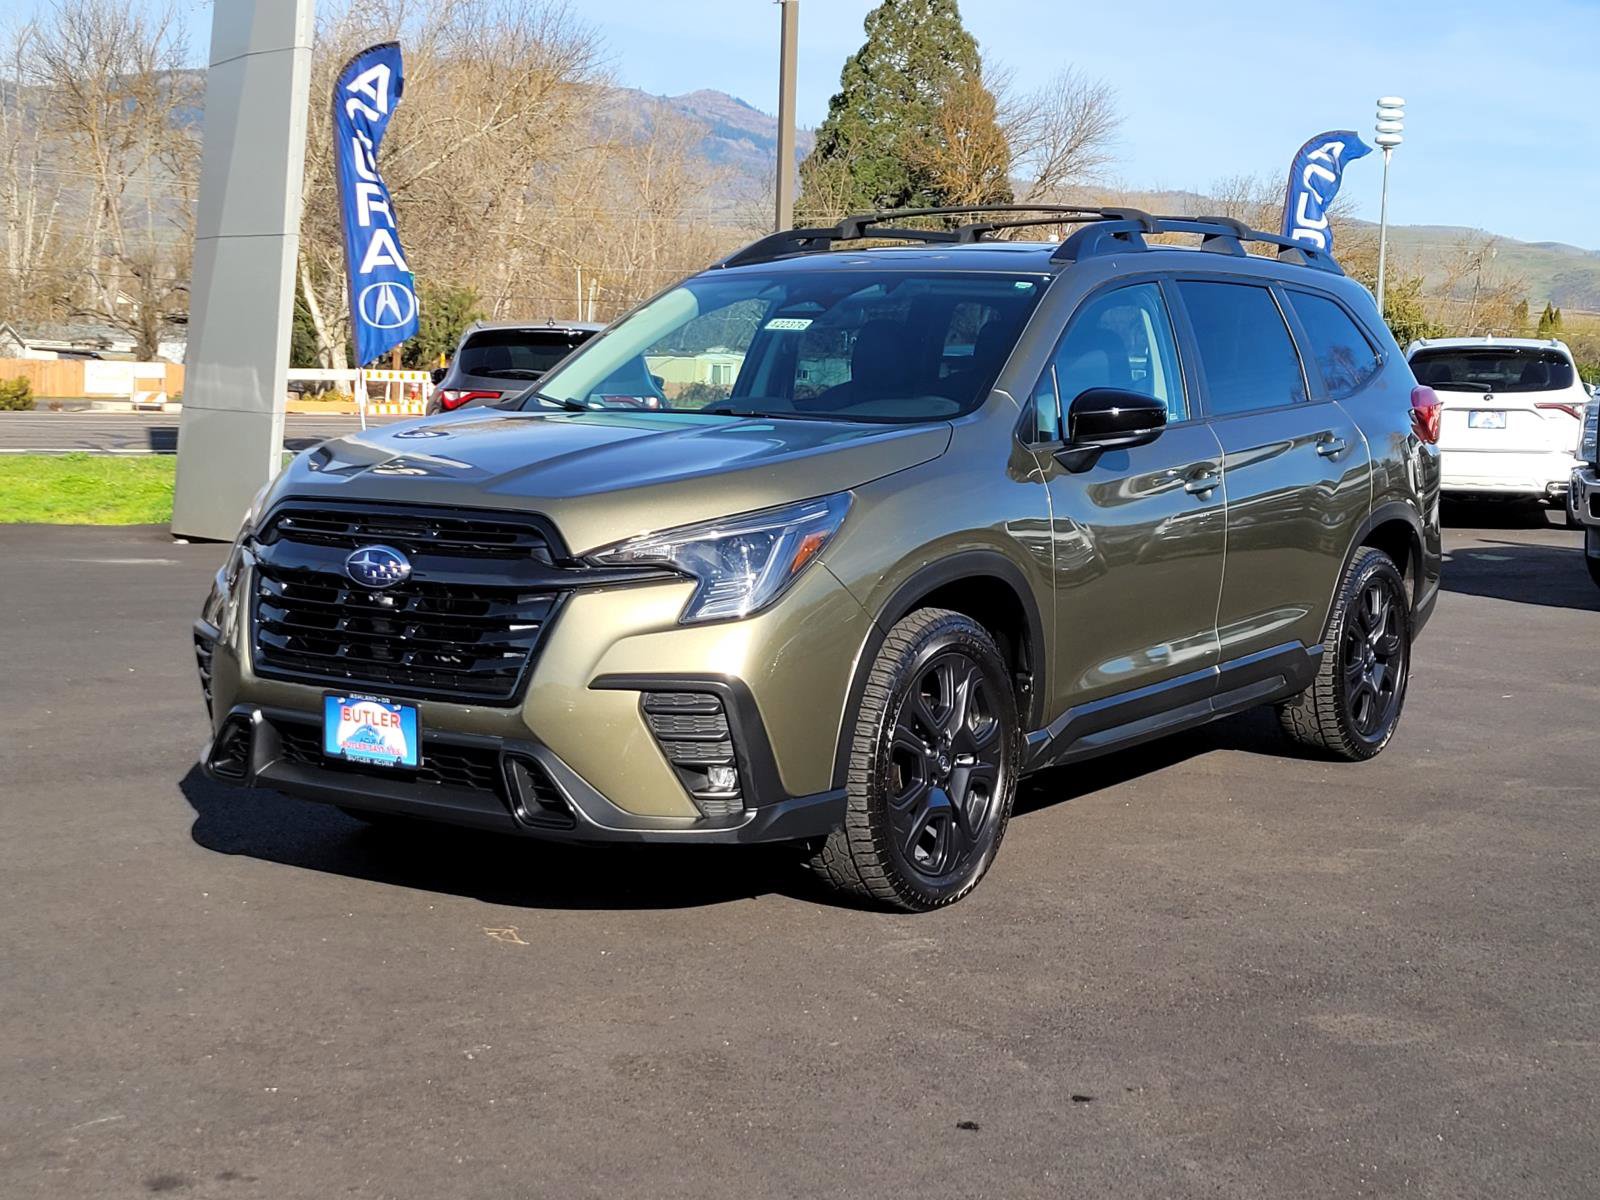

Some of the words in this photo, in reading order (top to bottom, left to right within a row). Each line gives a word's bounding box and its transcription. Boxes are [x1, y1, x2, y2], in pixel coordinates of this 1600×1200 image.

[346, 63, 409, 273] ACURA
[1291, 141, 1345, 249] ACU
[350, 693, 377, 702] ASHLAND
[342, 707, 400, 728] BUTLER
[347, 755, 371, 764] BUTLER
[373, 758, 394, 767] ACURA
